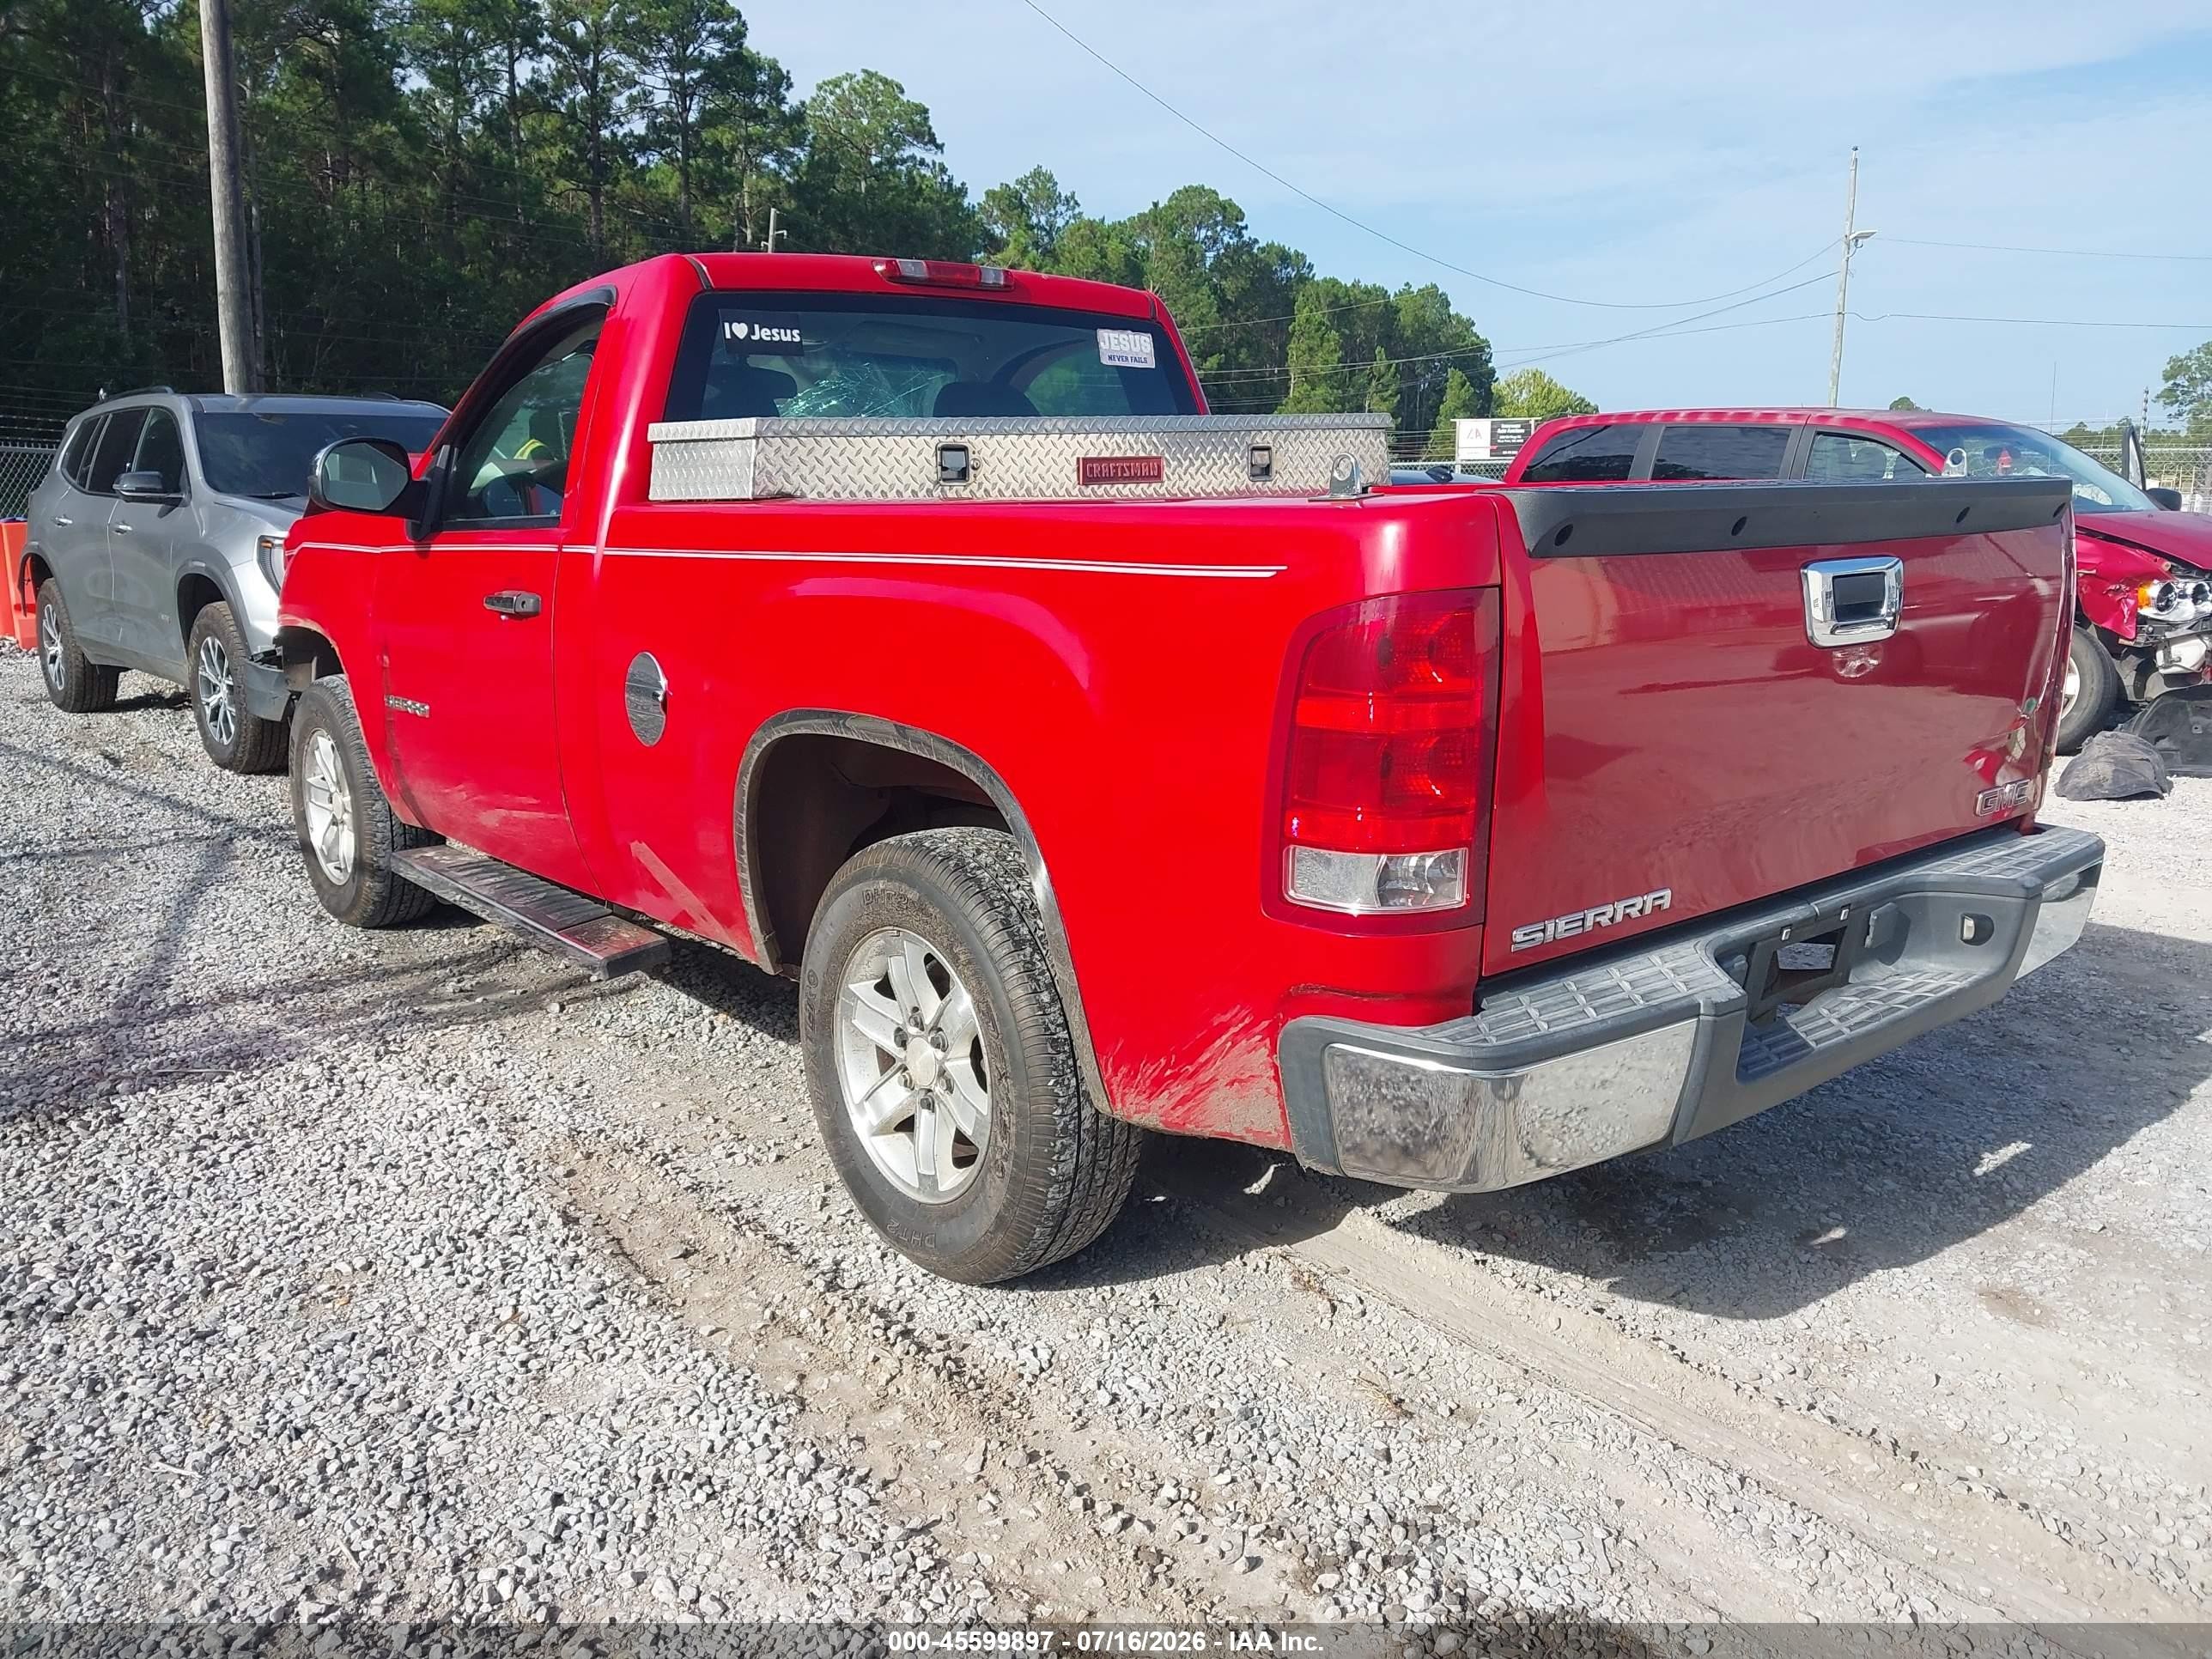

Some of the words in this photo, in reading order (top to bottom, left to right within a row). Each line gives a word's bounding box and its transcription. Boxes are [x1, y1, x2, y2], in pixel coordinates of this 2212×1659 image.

[724, 322, 732, 339] I
[750, 324, 801, 343] Jesus
[1100, 332, 1152, 353] JESUS
[1108, 354, 1129, 363] NEVER
[1086, 462, 1158, 478] CRAFTSMAN
[1975, 778, 2032, 817] GMC
[1511, 888, 1673, 953] SIERRA
